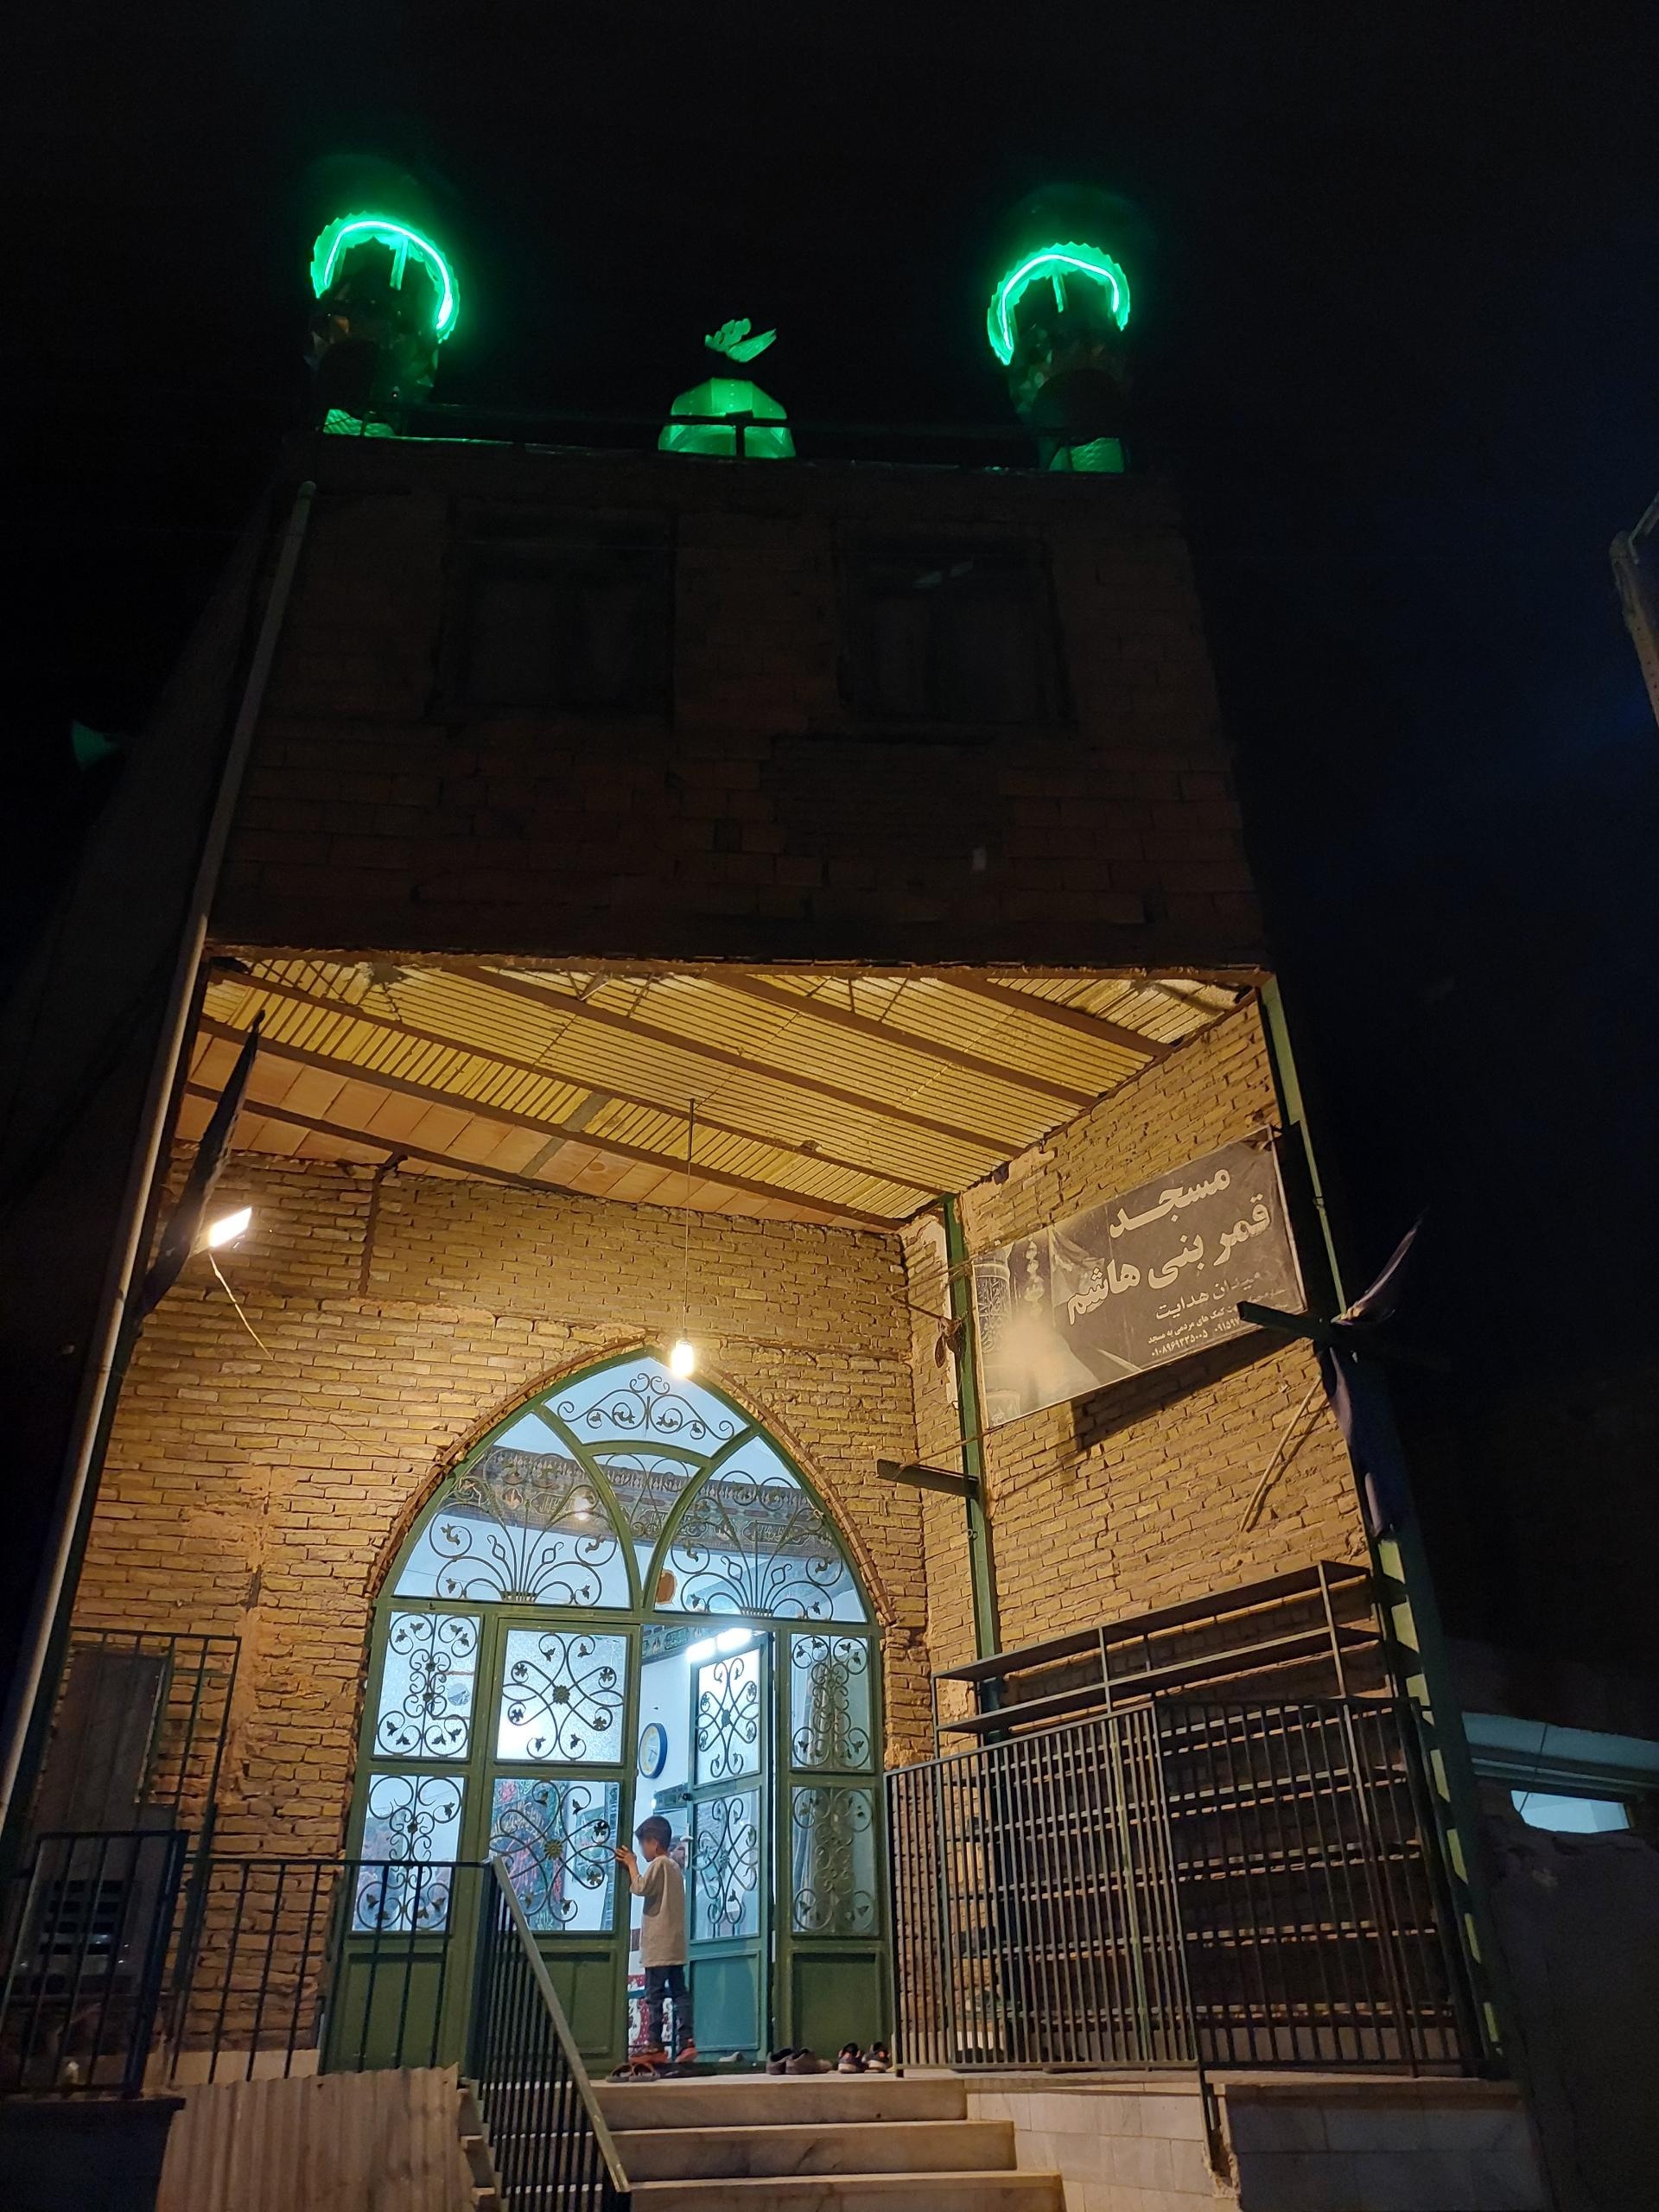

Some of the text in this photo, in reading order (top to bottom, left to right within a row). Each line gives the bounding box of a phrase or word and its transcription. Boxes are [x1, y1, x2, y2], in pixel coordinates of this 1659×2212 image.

[1109, 1169, 1230, 1238] مسجد
[1066, 1193, 1271, 1325] قمر بنی هاشم
[1212, 1272, 1261, 1300] میدان
[1156, 1290, 1210, 1320] هدایت
[1210, 1307, 1225, 1319] کمک
[1196, 1315, 1209, 1327] های
[1147, 1333, 1166, 1344] مسجد
